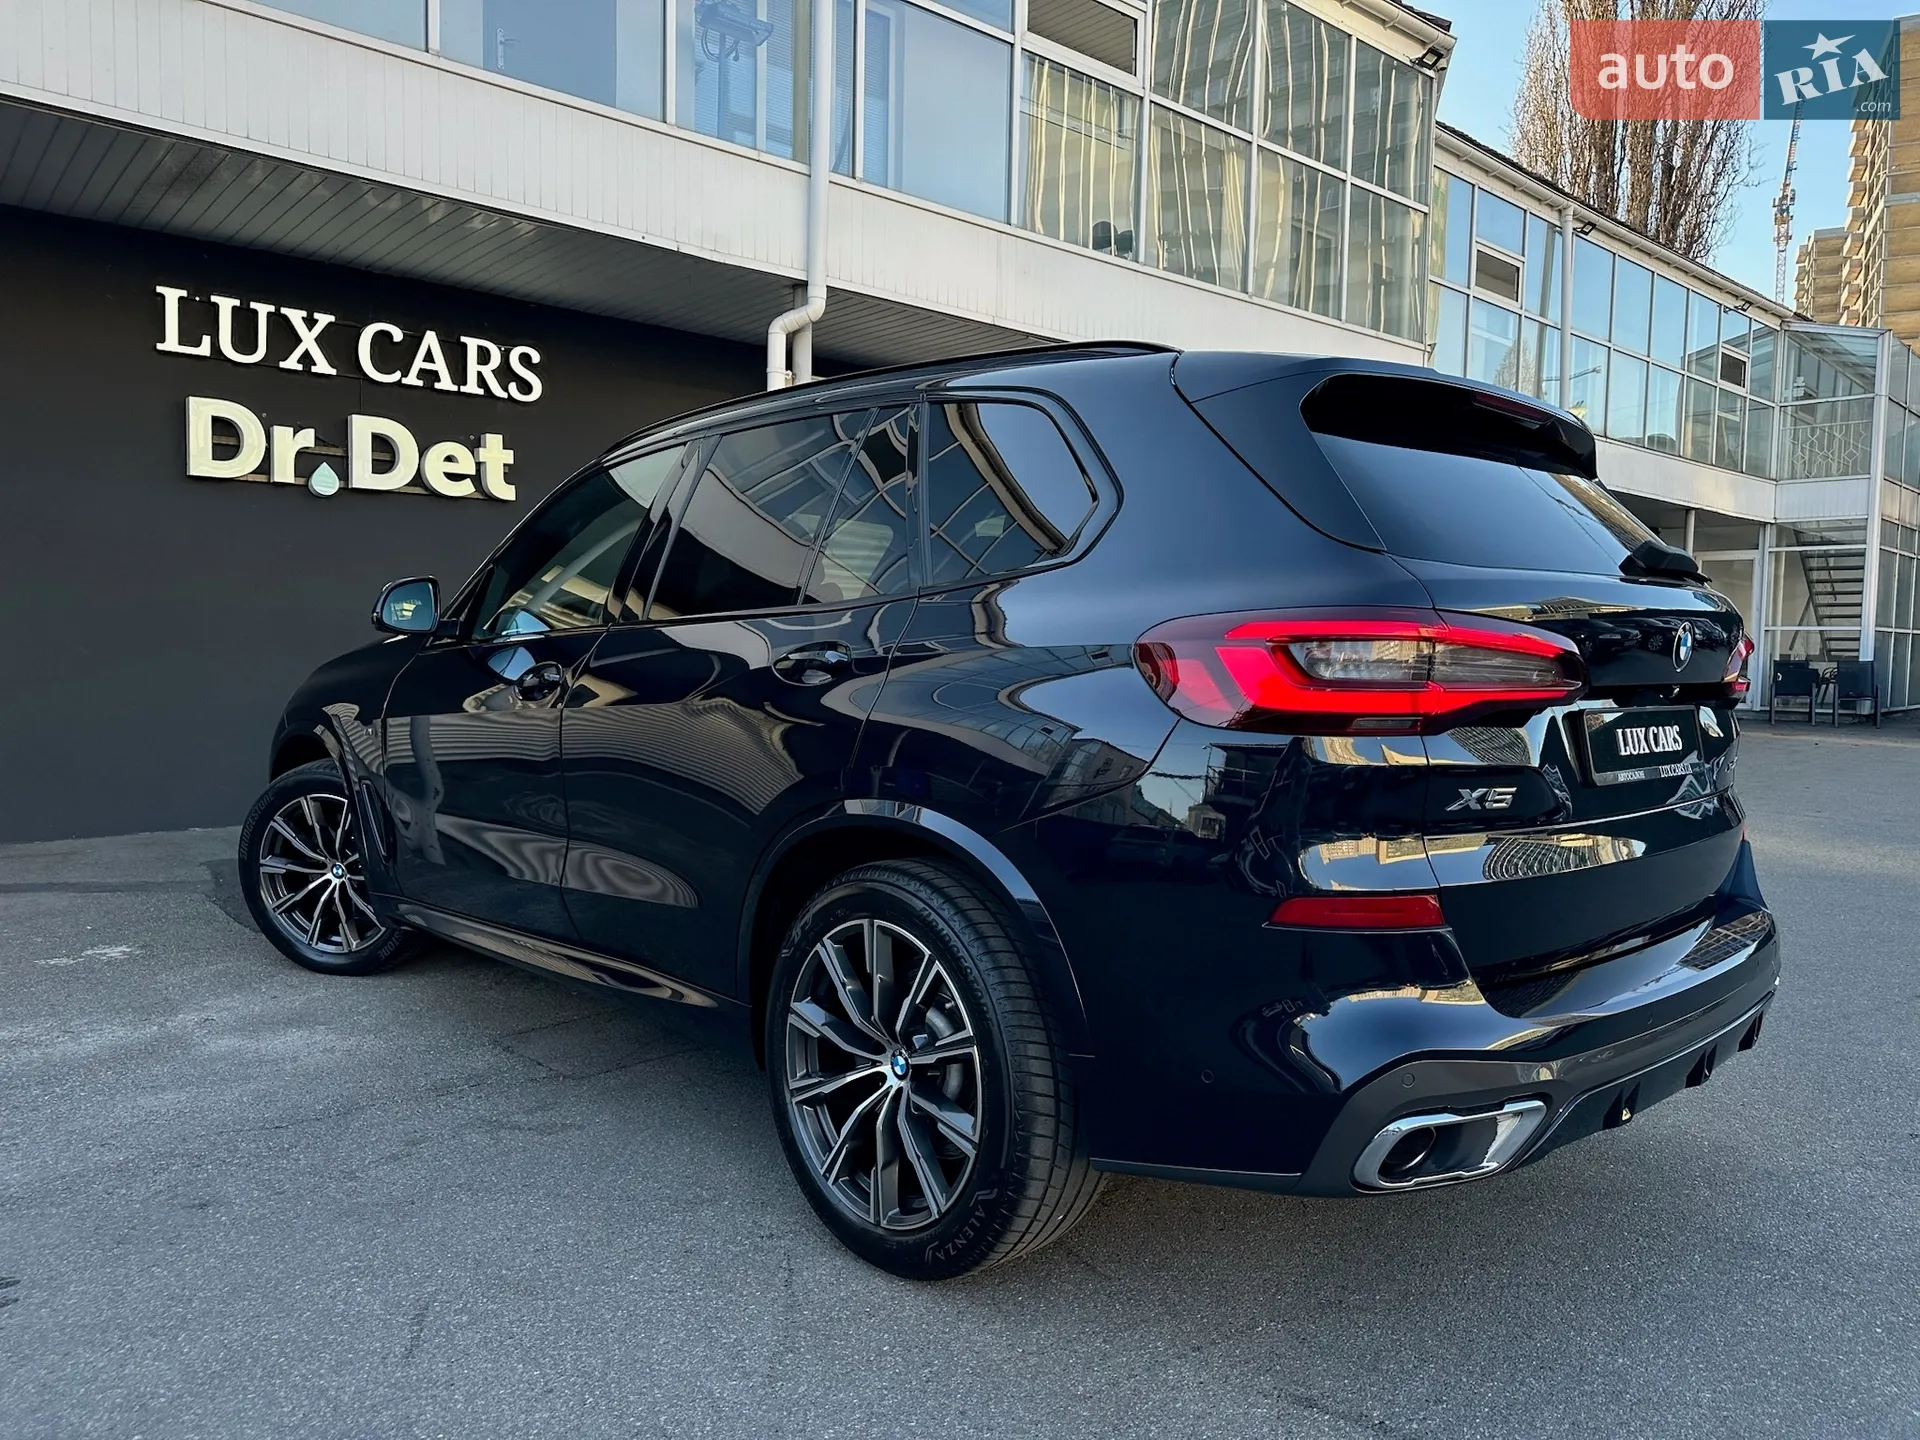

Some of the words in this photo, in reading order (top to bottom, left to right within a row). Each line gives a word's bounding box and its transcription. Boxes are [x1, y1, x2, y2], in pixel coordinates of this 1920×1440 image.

[155, 285, 338, 376] LUX
[357, 322, 544, 403] CARS
[1616, 727, 1650, 756] LUX
[1650, 725, 1683, 751] CARS
[1445, 787, 1517, 811] X5
[934, 1203, 986, 1261] ALENZA
